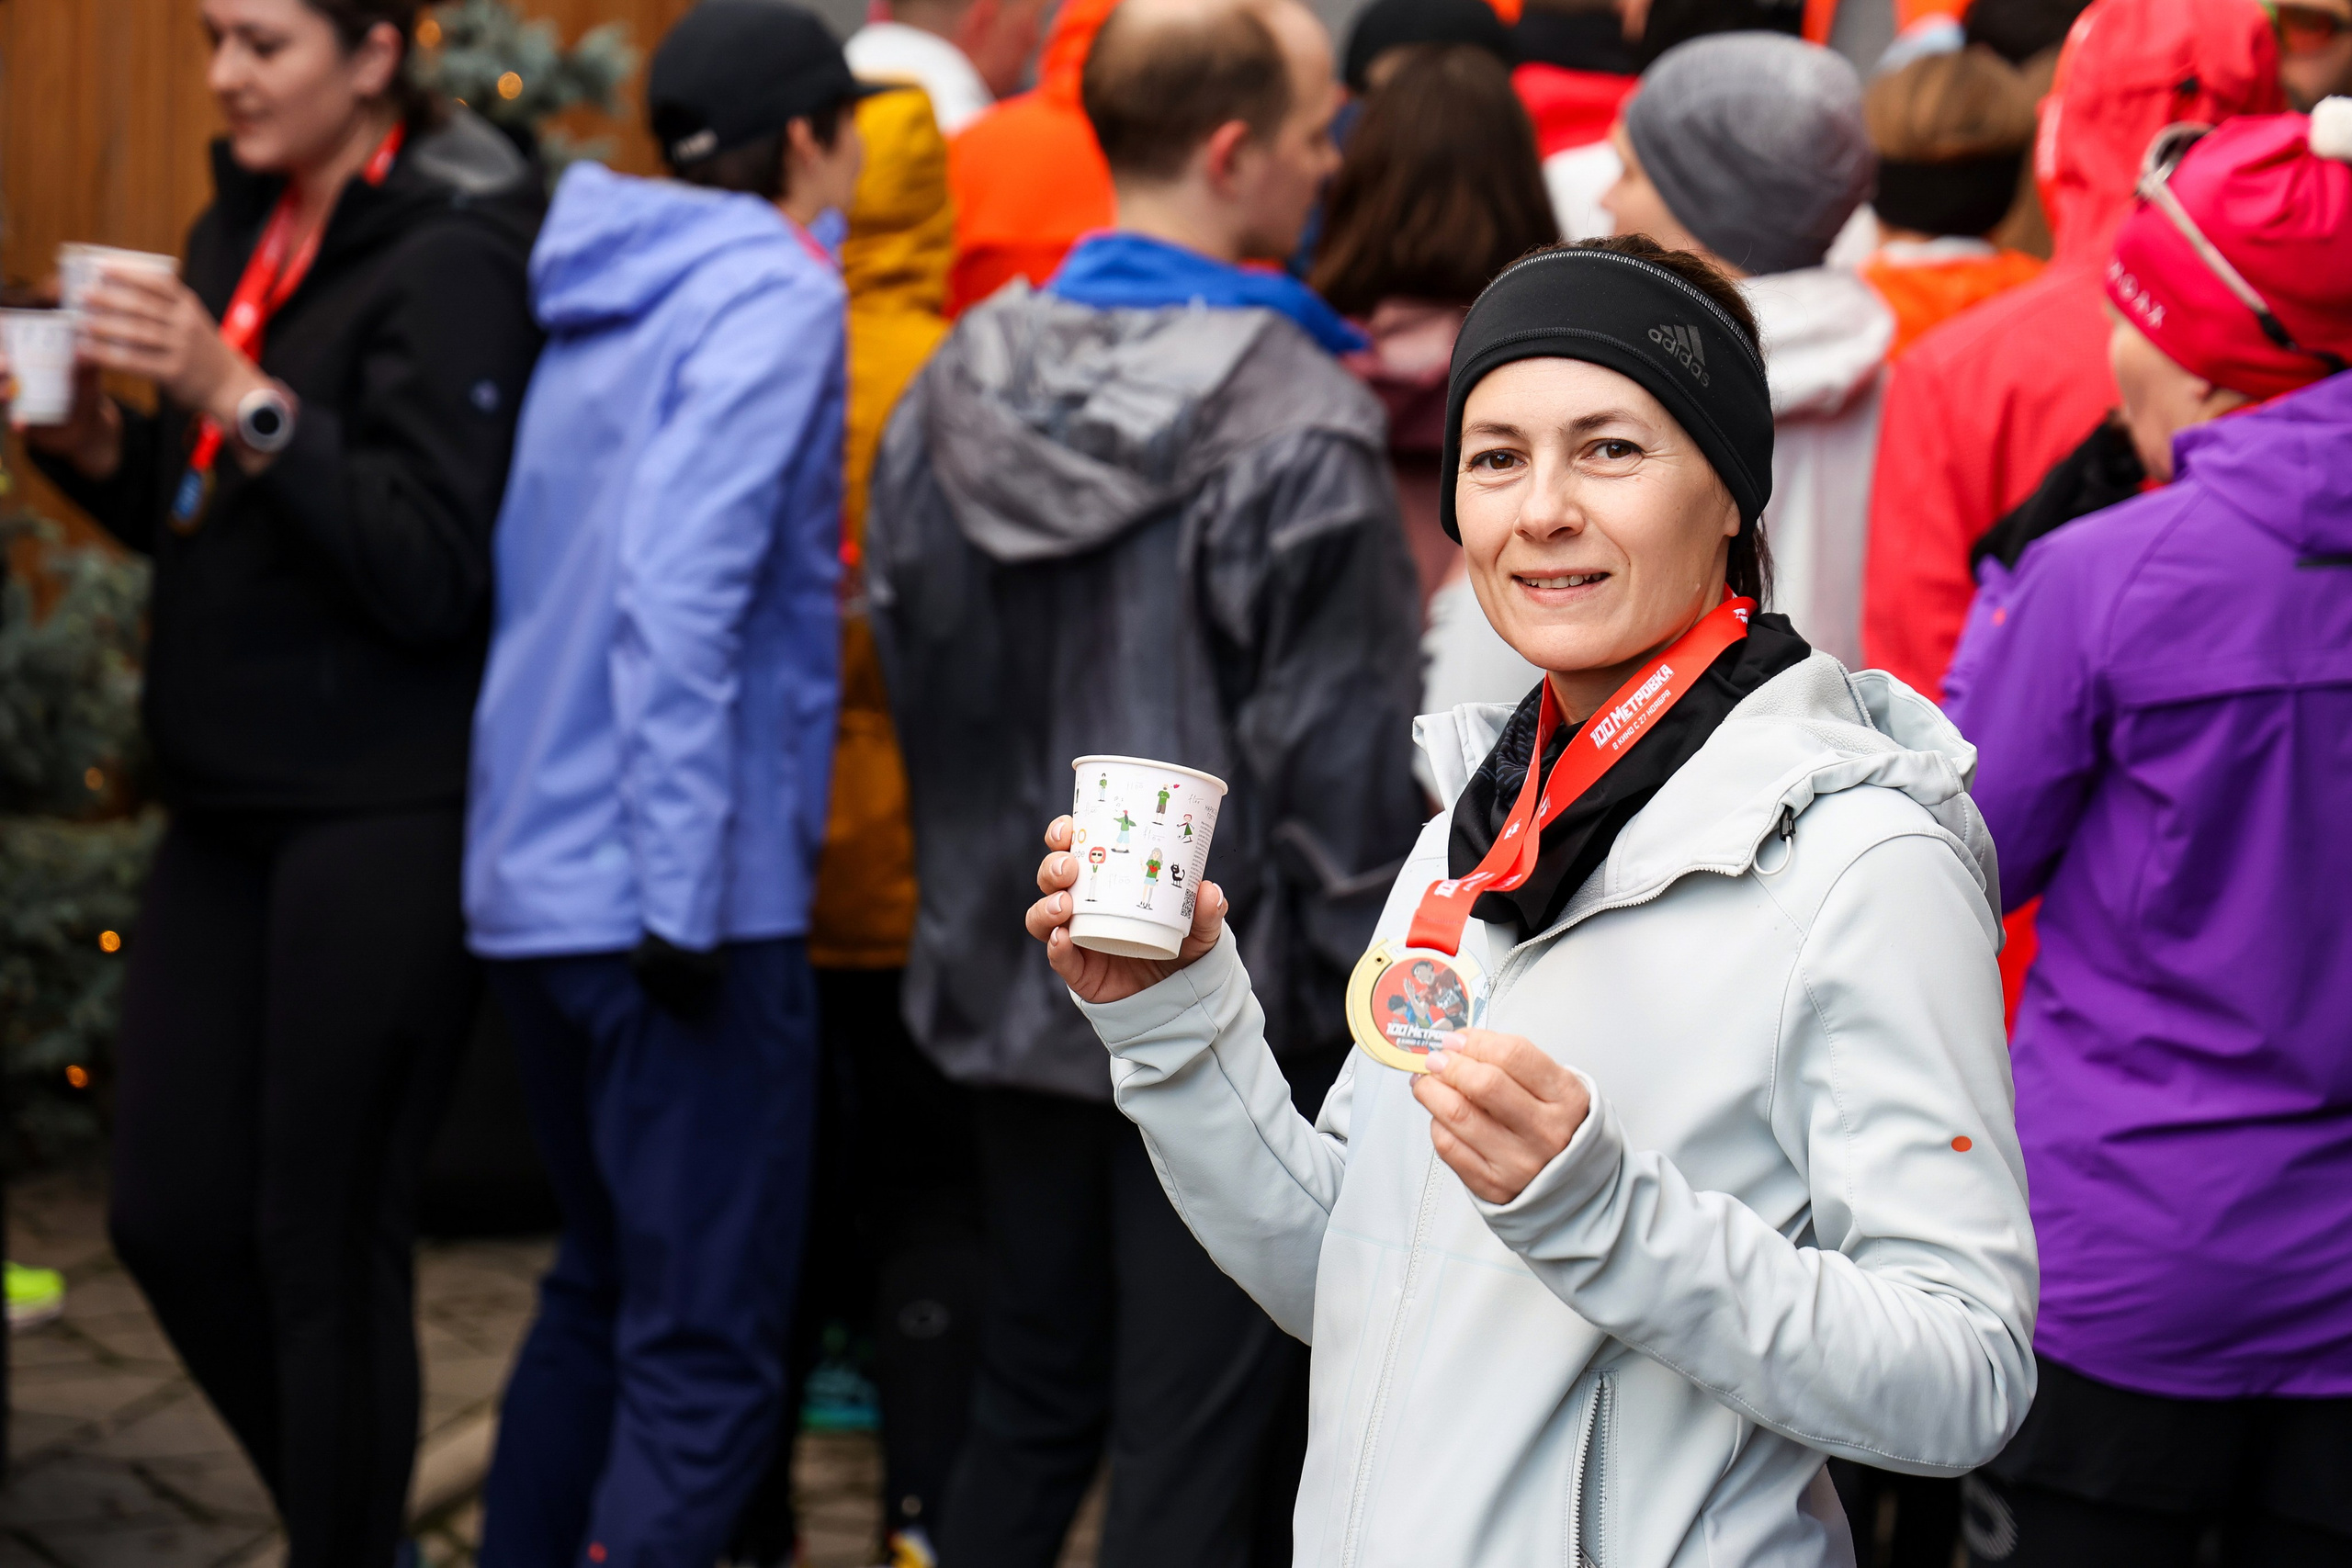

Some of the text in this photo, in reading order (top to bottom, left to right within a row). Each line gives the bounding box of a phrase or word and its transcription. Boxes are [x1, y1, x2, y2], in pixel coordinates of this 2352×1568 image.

[1647, 328, 1711, 389] adidas
[1611, 689, 1672, 750] В КИНО С 27 НОЯБРЯ
